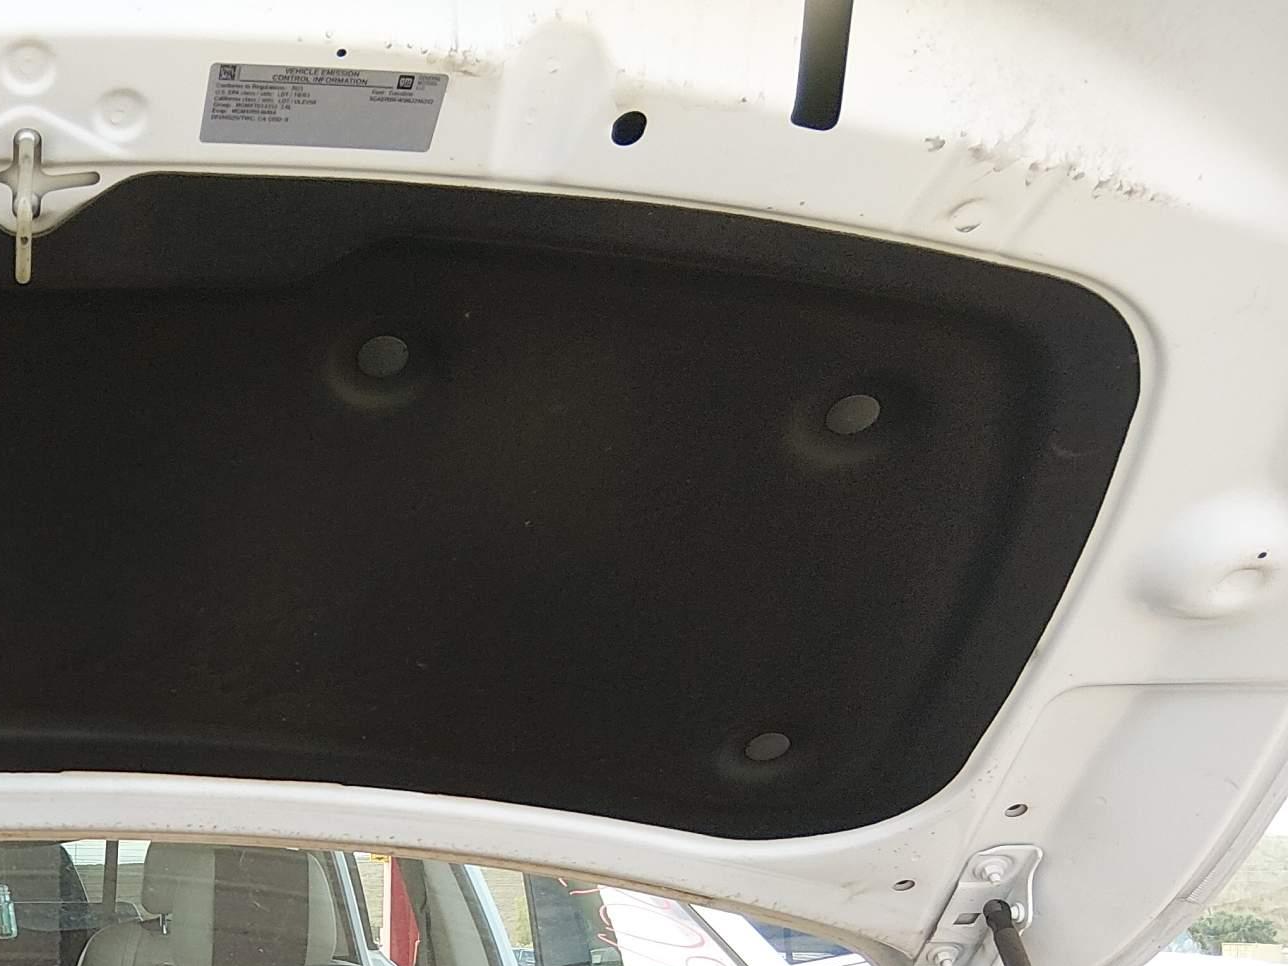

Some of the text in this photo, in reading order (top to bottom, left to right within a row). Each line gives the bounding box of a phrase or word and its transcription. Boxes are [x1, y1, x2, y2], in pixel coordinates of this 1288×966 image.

[285, 67, 318, 75] VEHICLE
[272, 74, 368, 85] CONTROL INFORMATION
